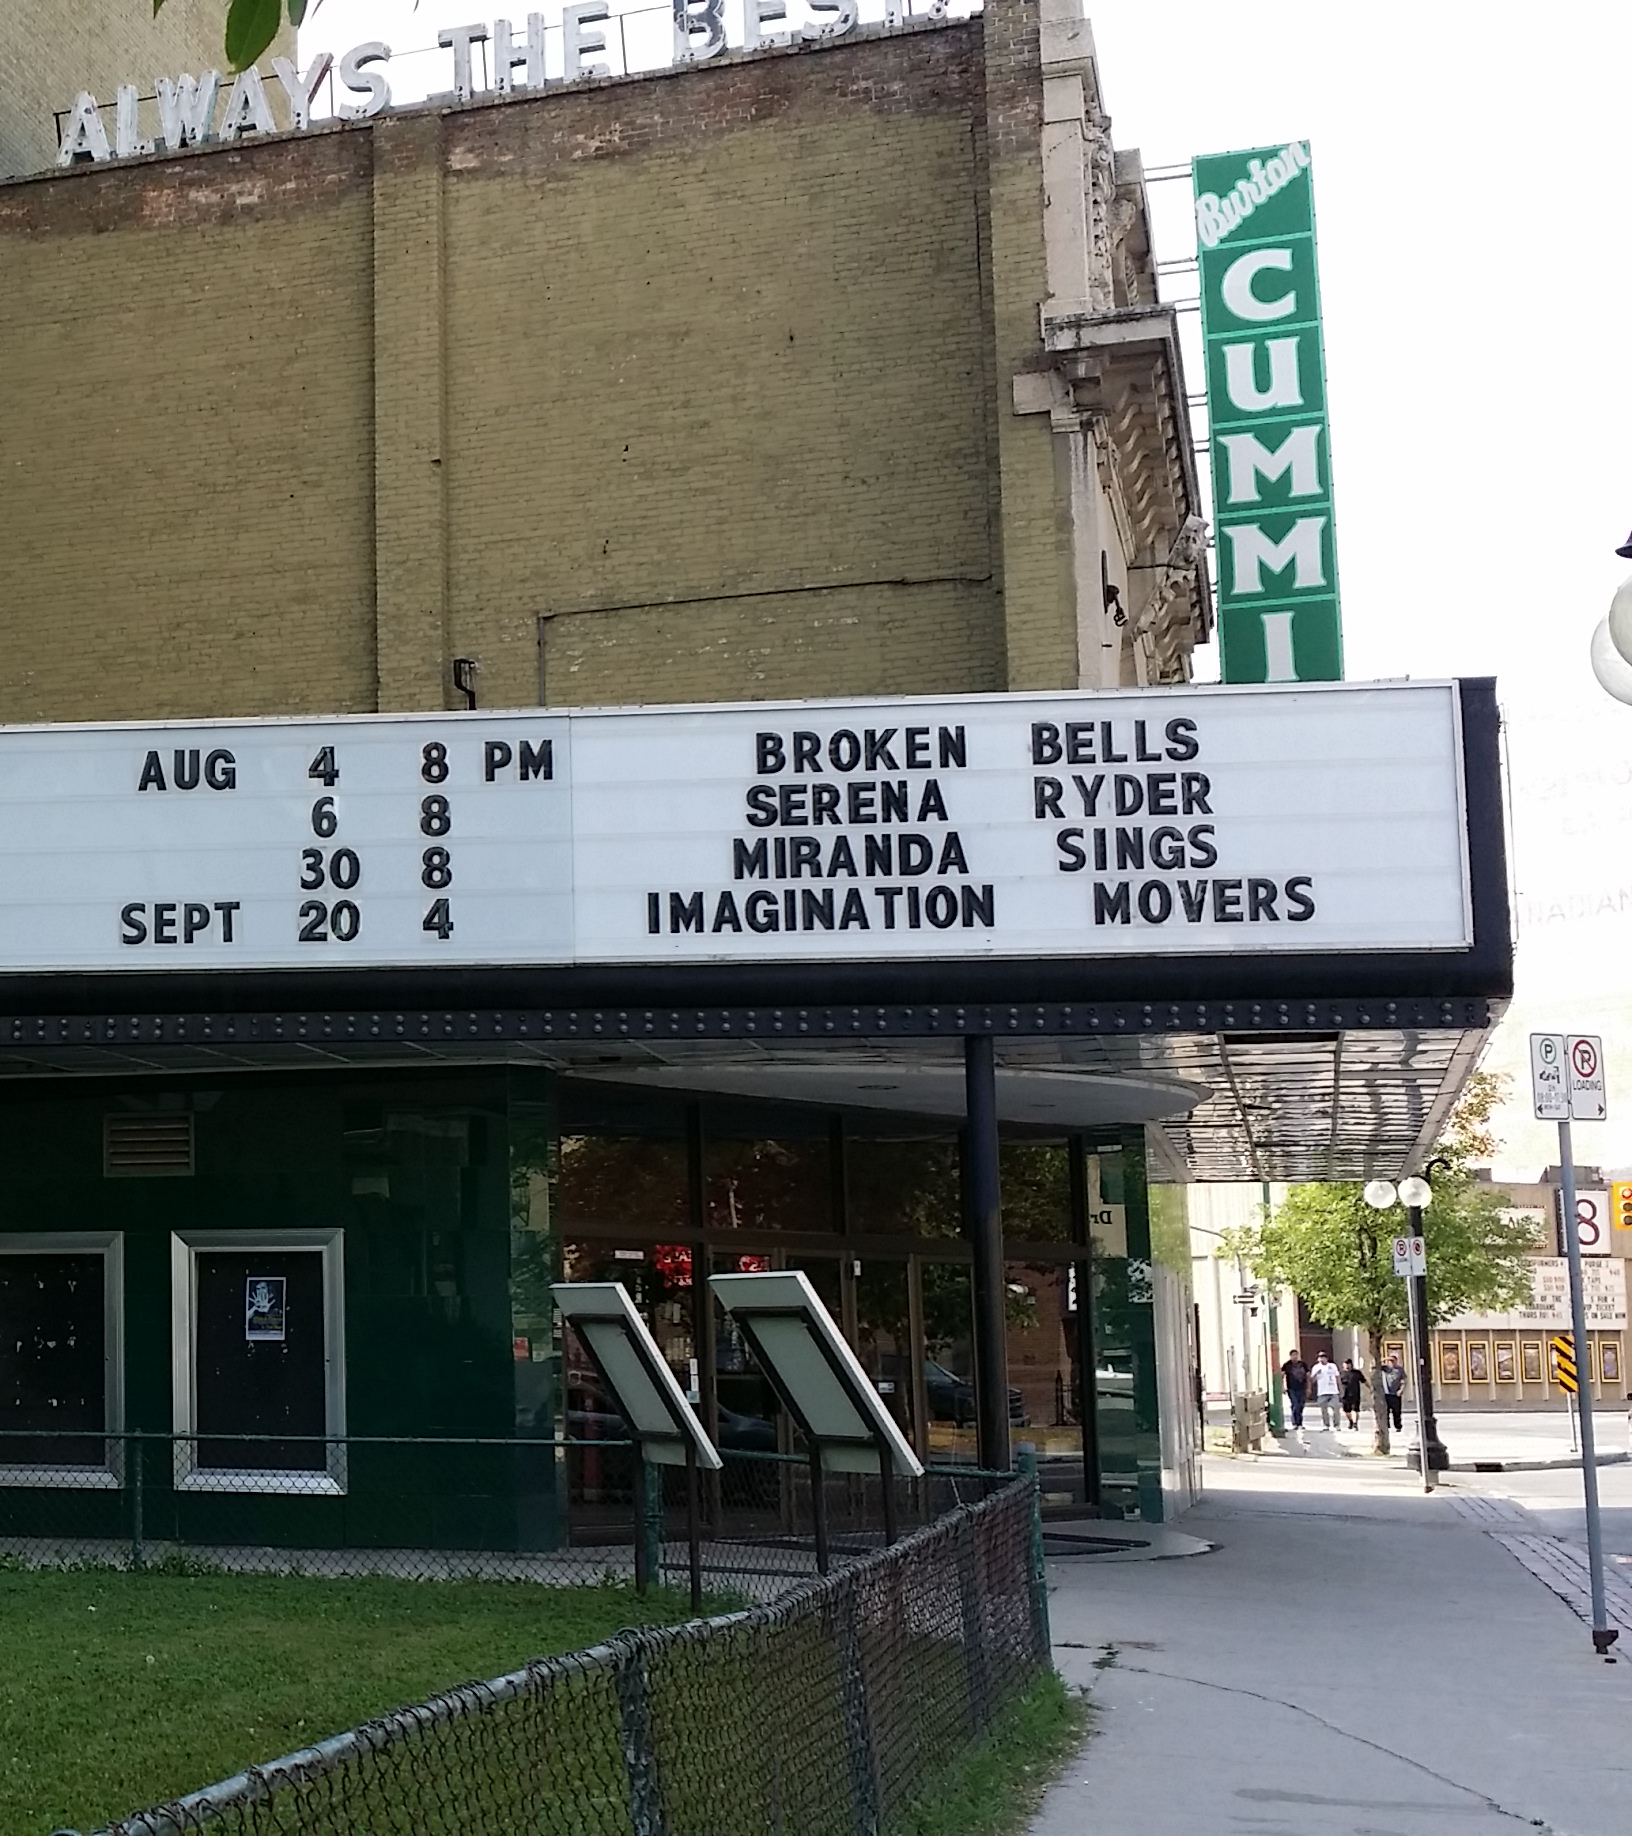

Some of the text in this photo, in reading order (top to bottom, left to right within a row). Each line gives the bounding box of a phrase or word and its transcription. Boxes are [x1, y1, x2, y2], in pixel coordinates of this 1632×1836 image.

[56, 41, 392, 166] ALWAYS
[437, 1, 611, 99] THE
[1195, 142, 1311, 247] Burton
[138, 717, 1200, 792] AUG 4 8 PM BROKEN BELLS
[311, 772, 1213, 838] 6 8 SERENA RYDER
[300, 824, 1218, 890] 30 8 MIRANDA SINGS
[121, 876, 1315, 945] SEPT 20 4 IMAGINATION MOVERS
[1573, 1080, 1602, 1091] LOADING
[1576, 1199, 1600, 1245] 8
